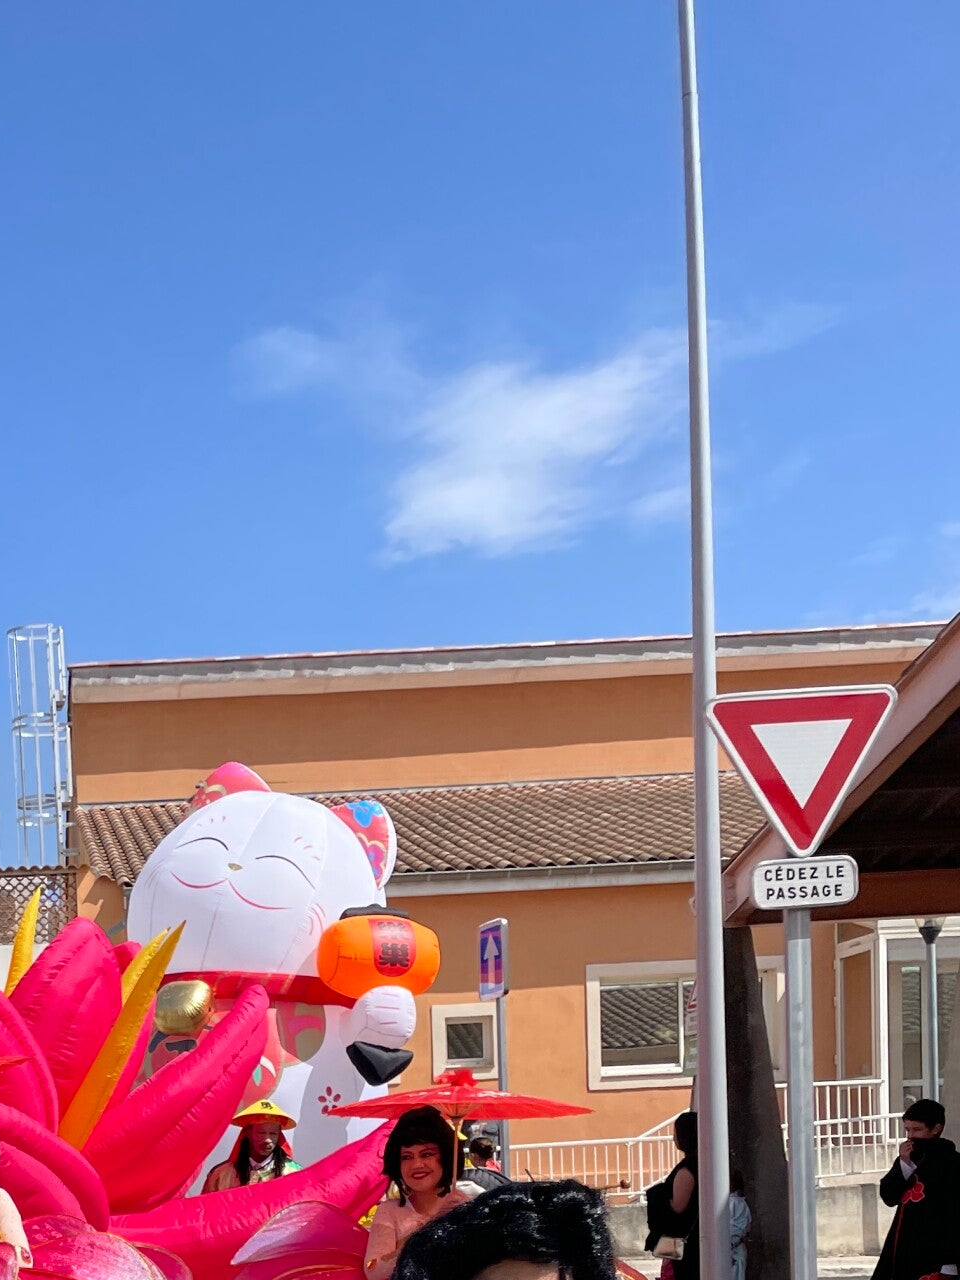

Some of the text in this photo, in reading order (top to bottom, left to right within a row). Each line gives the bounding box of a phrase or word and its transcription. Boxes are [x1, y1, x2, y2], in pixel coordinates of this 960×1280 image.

[764, 865, 845, 882] CÉDEZ LE
[766, 884, 843, 900] PASSAGE
